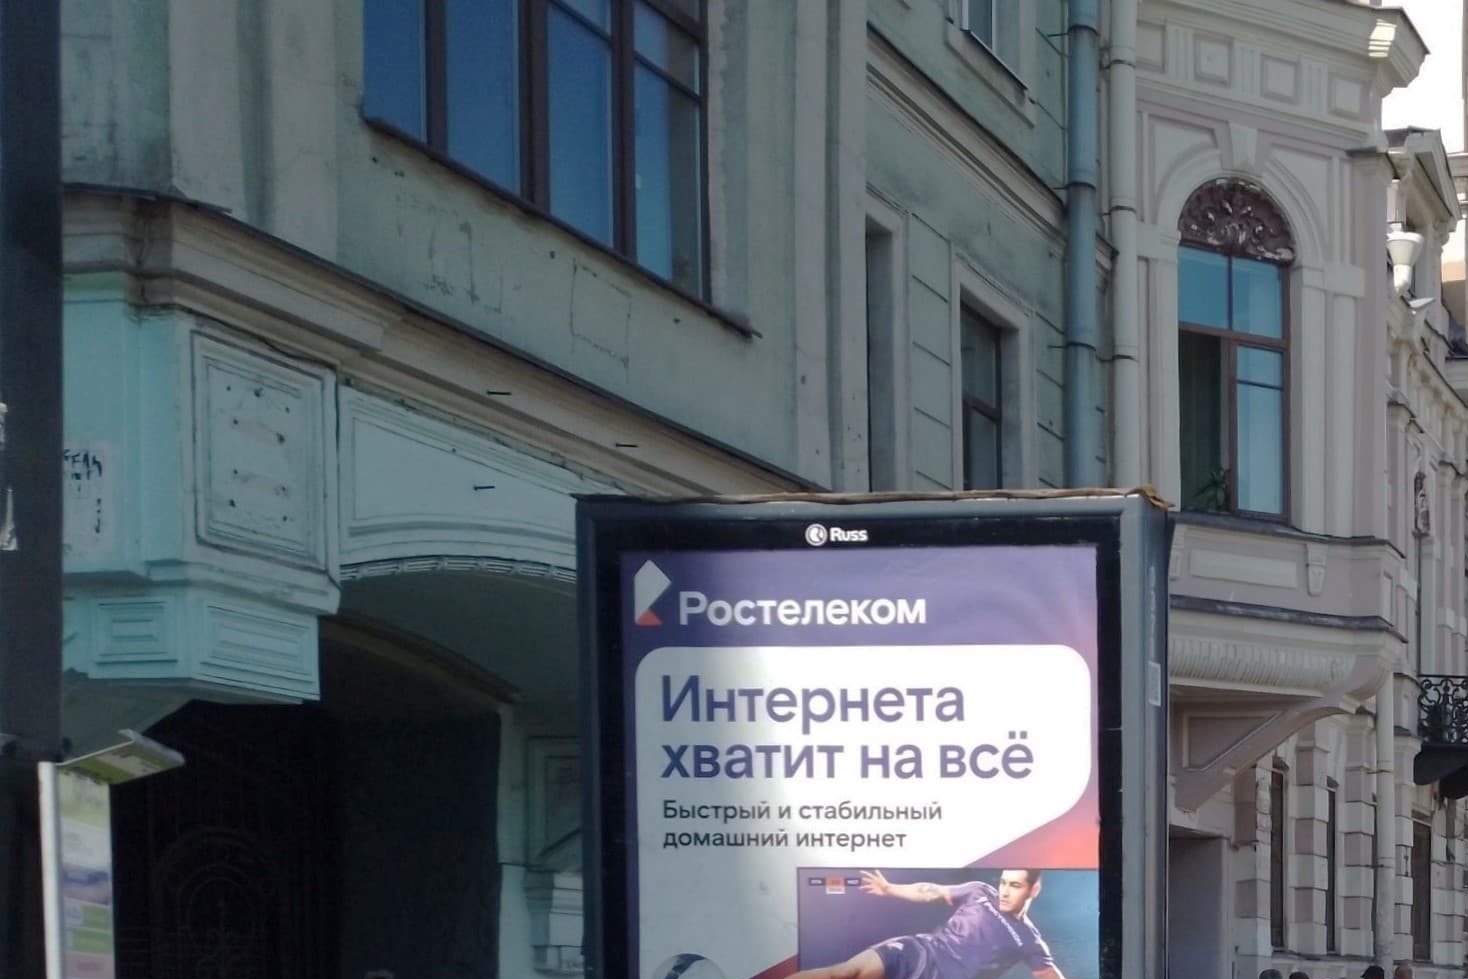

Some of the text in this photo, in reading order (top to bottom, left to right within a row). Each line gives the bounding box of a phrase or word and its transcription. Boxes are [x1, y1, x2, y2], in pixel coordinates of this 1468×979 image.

[829, 527, 868, 542] Russ
[678, 591, 927, 626] Ростелеком
[661, 674, 965, 735] Интернета
[660, 730, 1034, 779] хватит на всё
[662, 799, 943, 826] Быстрый и стабильный
[662, 829, 907, 854] домашний интернет
